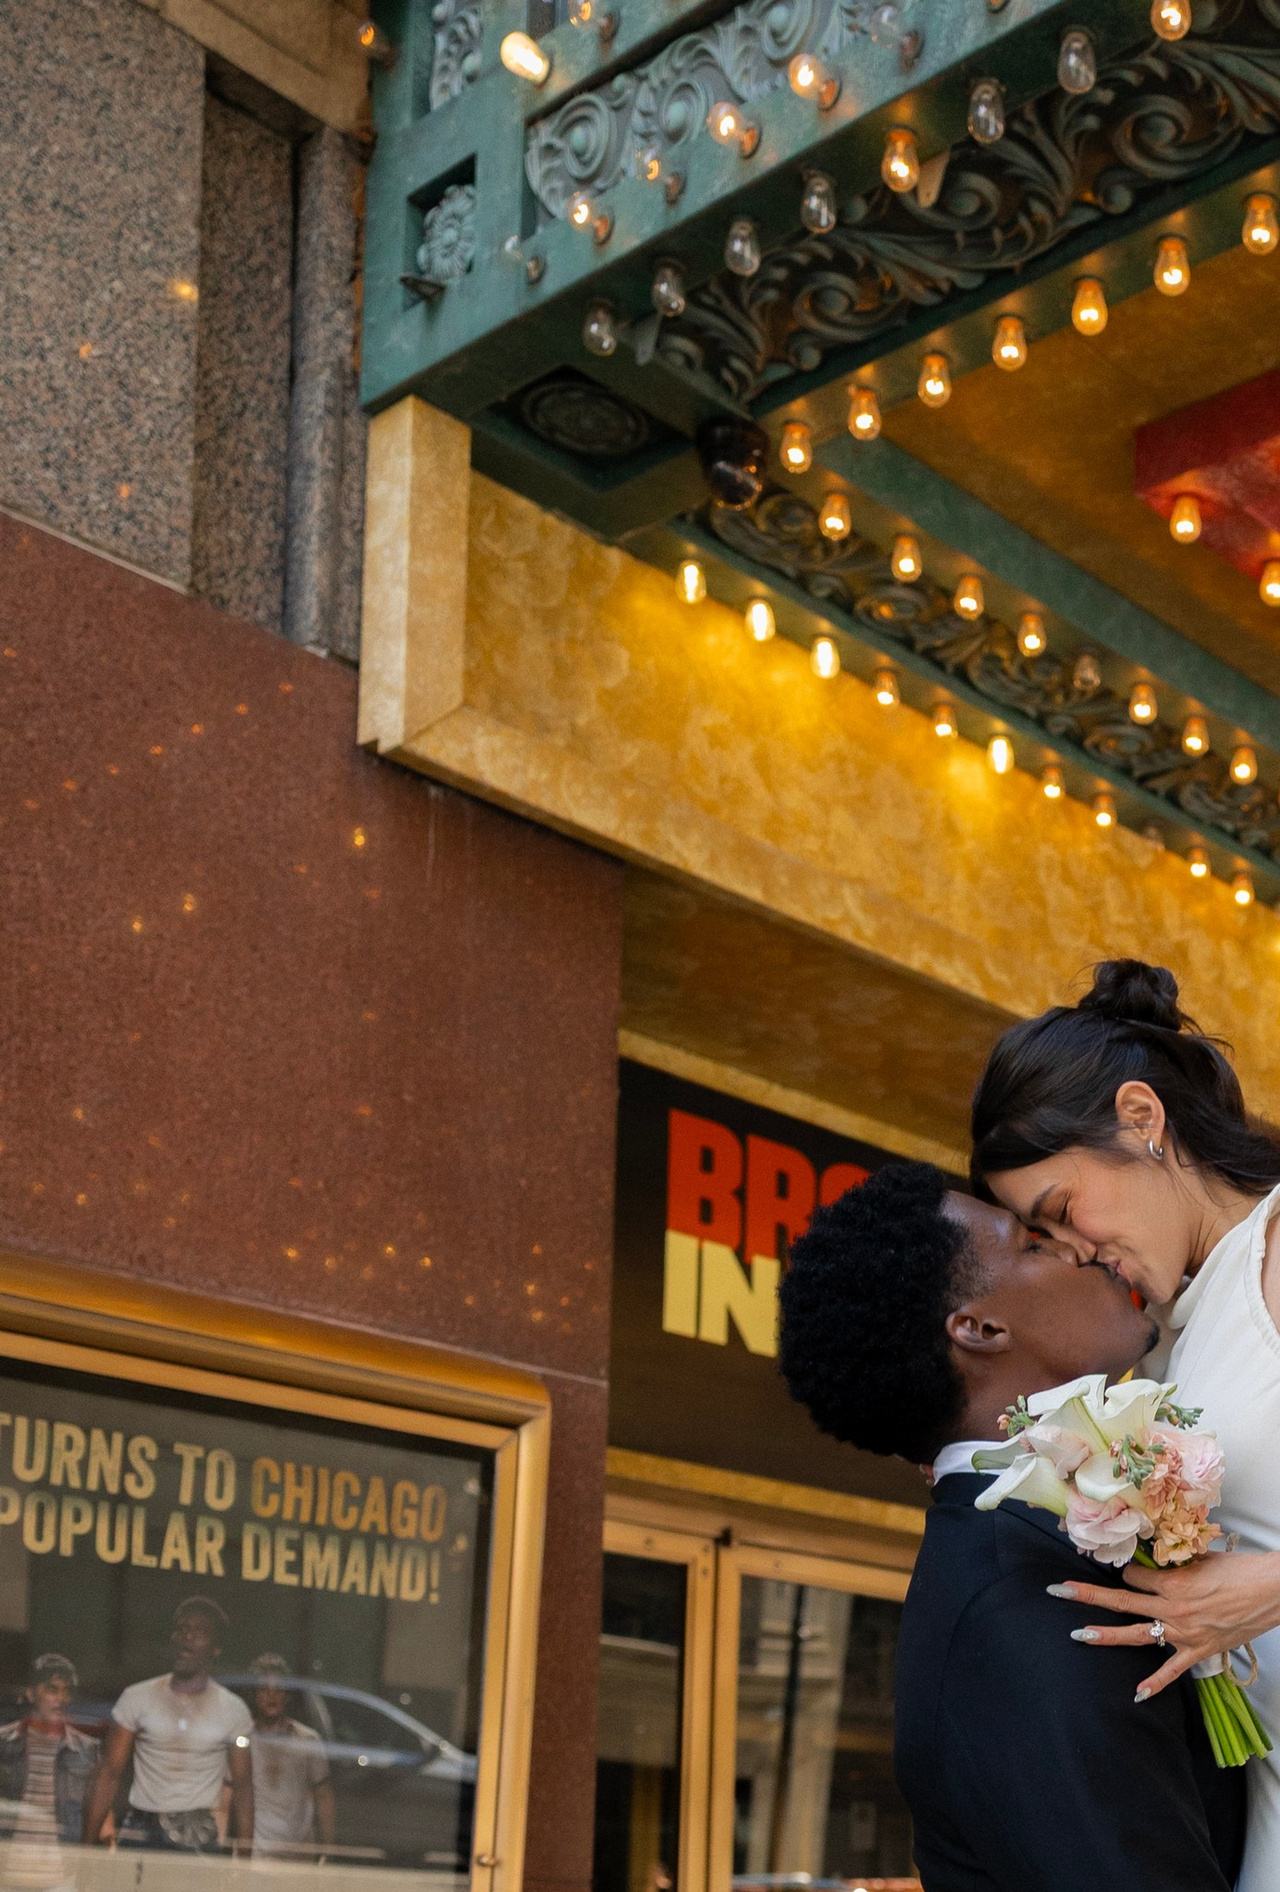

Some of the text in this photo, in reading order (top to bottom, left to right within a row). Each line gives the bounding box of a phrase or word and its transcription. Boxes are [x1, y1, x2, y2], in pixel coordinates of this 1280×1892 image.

[662, 1228, 780, 1358] IN
[172, 1441, 237, 1511] TO
[252, 1457, 448, 1543] CHICAGO
[241, 1522, 441, 1604] DEMAND!
